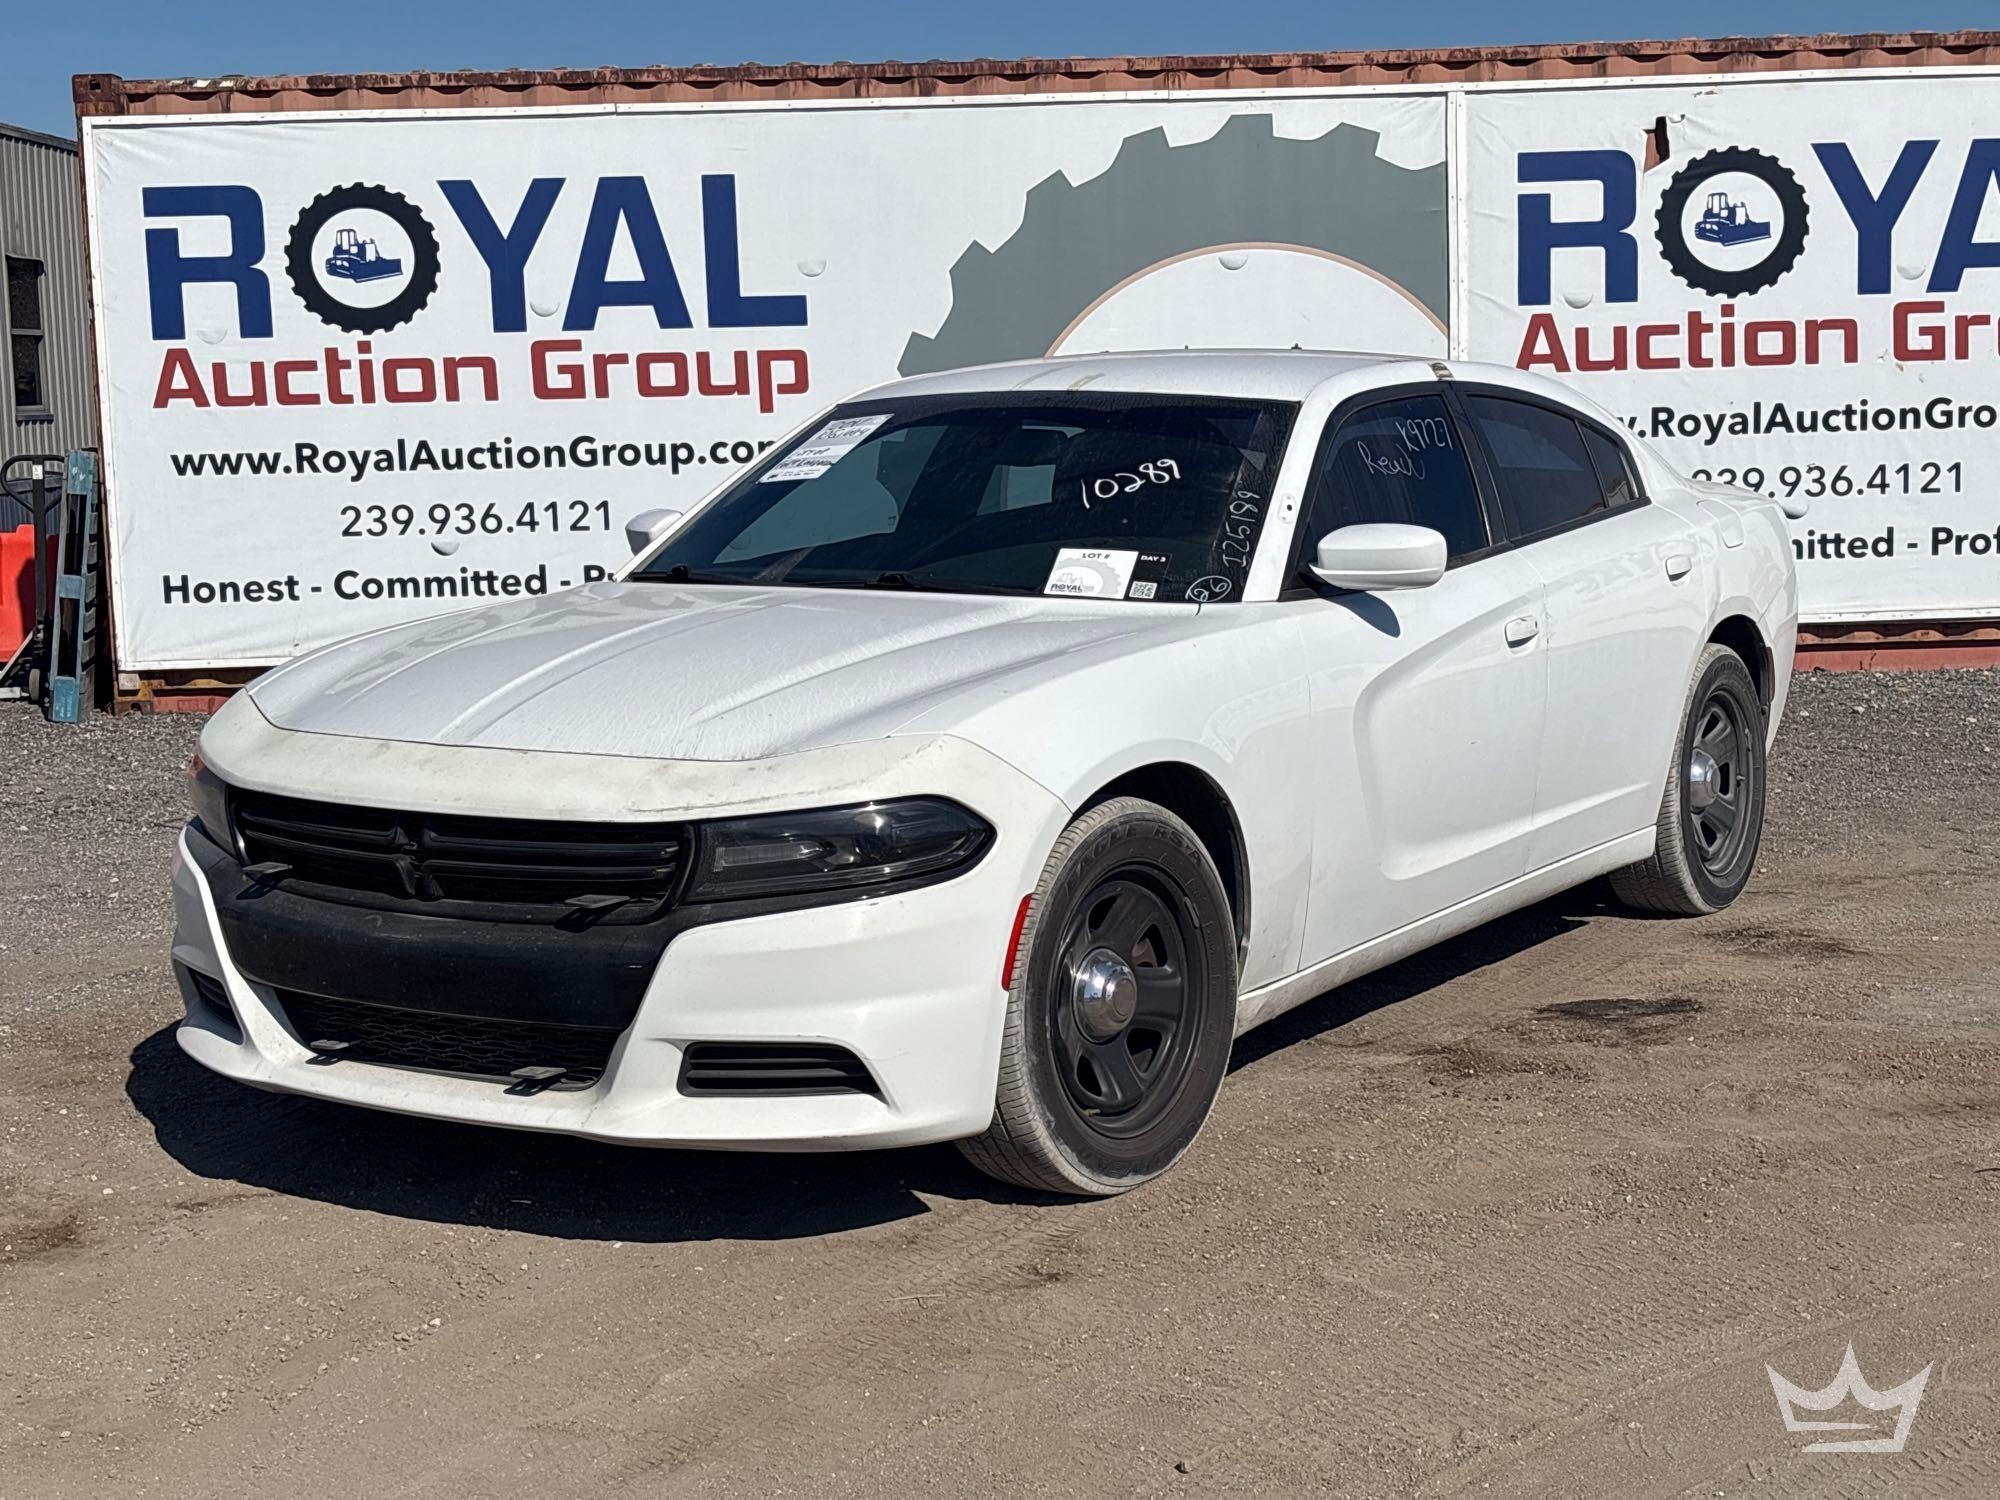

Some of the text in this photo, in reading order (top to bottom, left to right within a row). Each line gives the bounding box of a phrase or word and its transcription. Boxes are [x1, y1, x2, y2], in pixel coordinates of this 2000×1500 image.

[143, 173, 808, 340] ROYAL
[1516, 300, 2000, 373] Auction Gr
[152, 339, 809, 413] Auction Group
[1081, 458, 1181, 509] 10289
[341, 501, 610, 538] 239.936.4121
[163, 574, 300, 604] Honest
[333, 564, 548, 600] Committed
